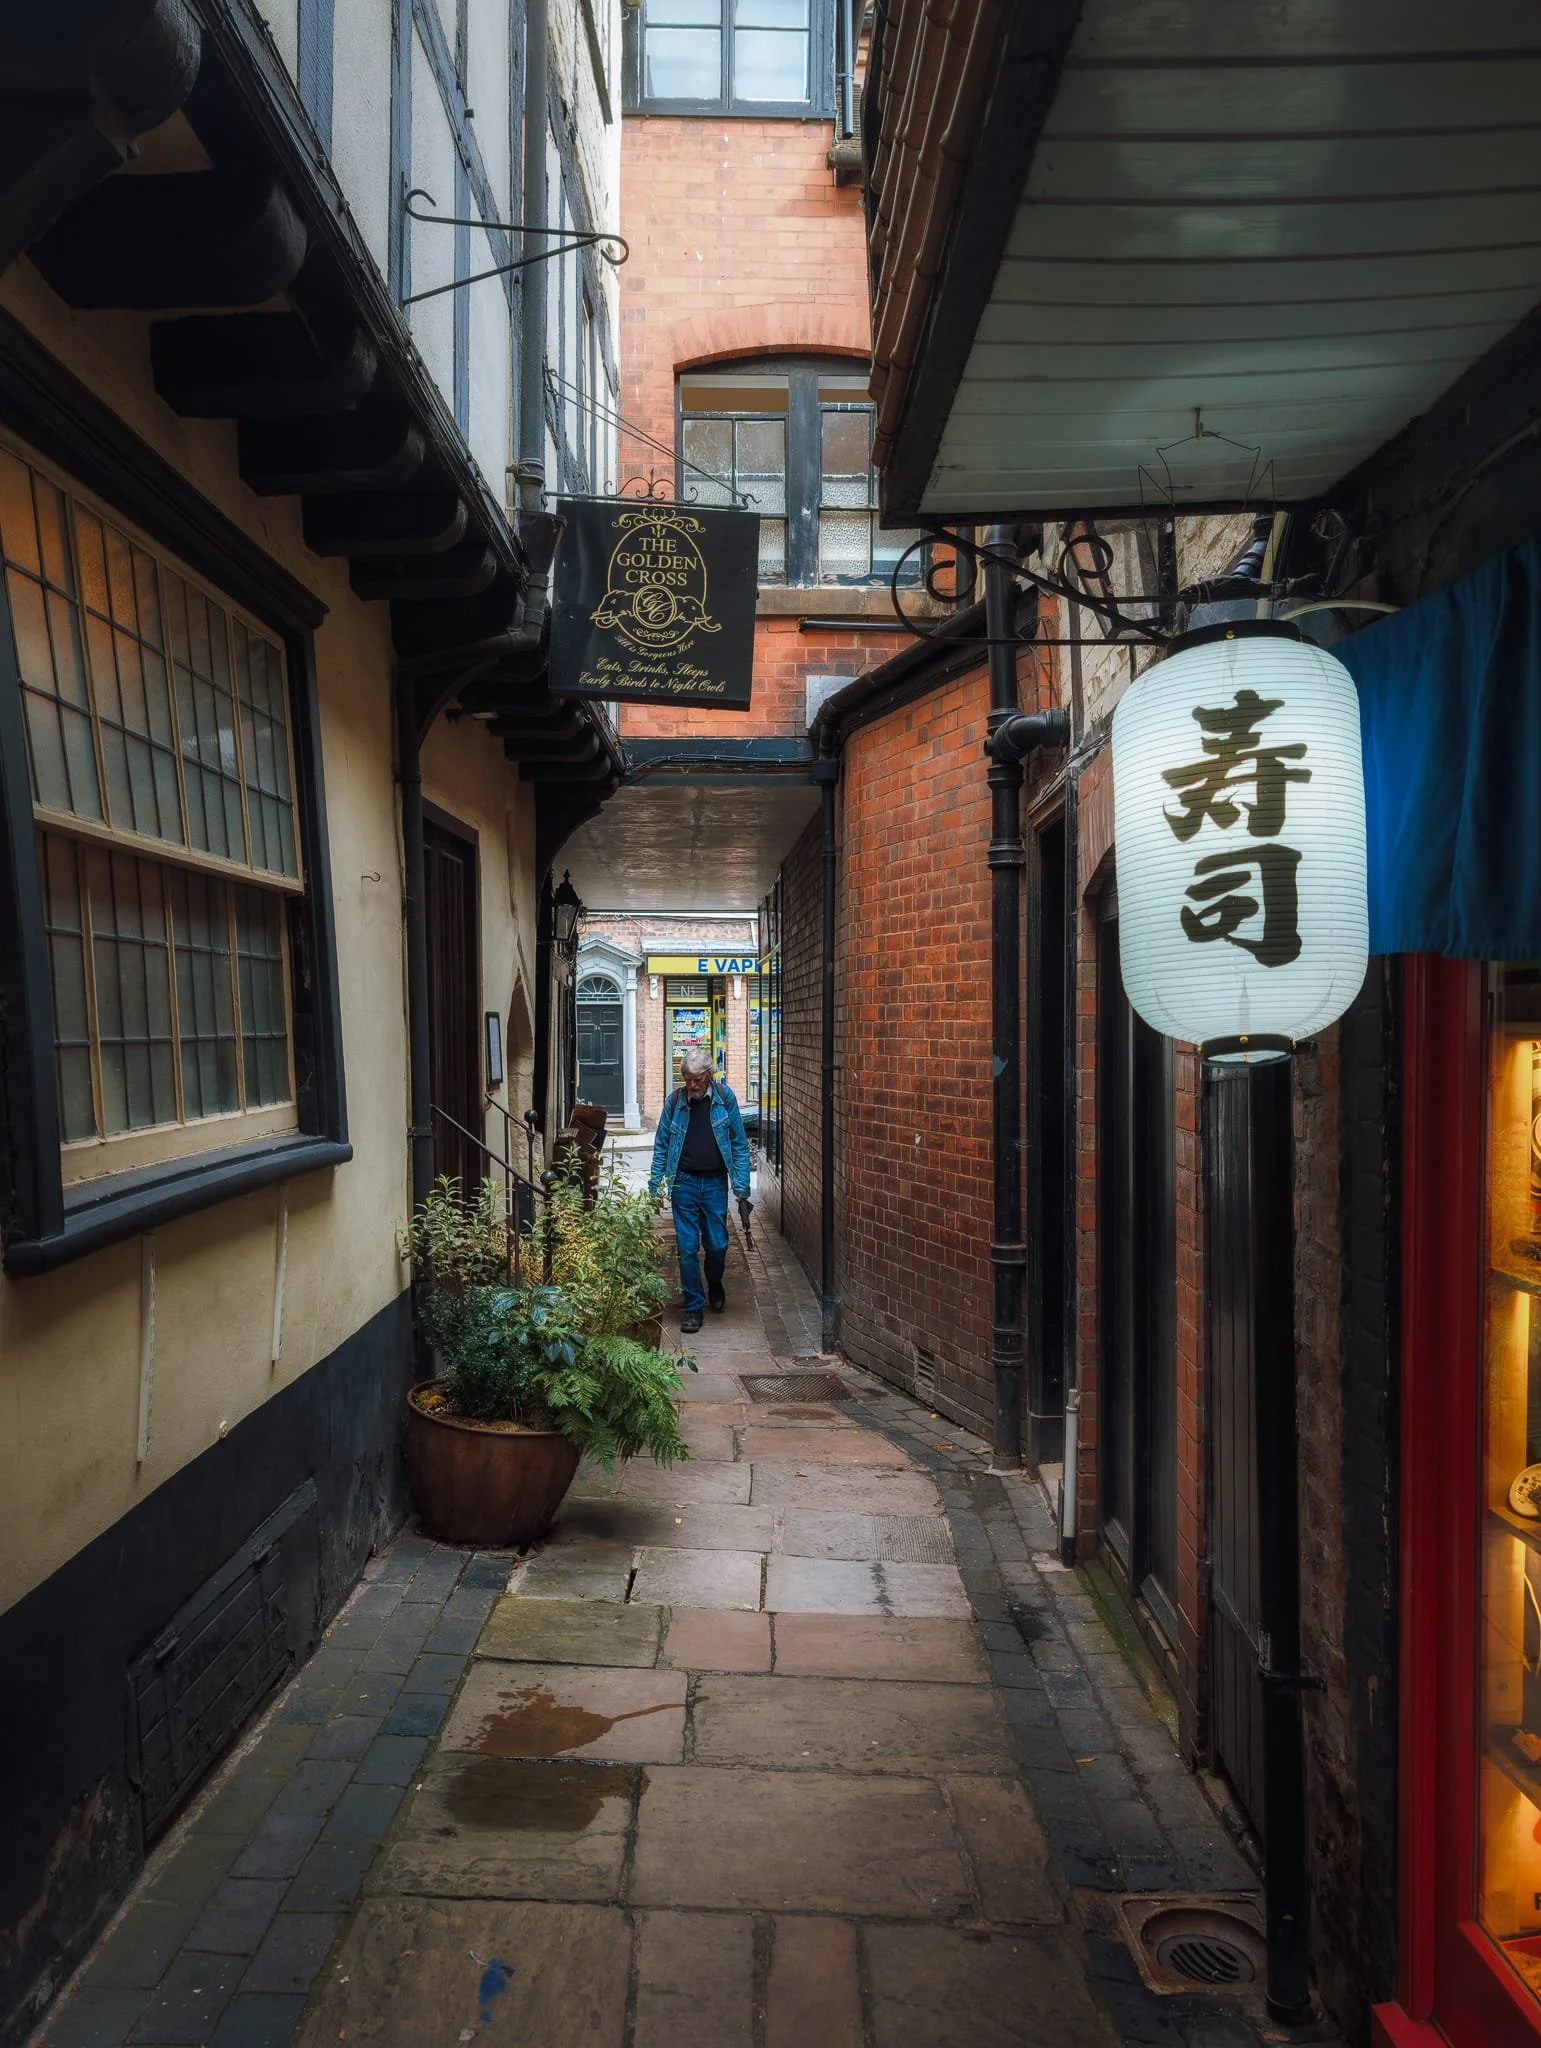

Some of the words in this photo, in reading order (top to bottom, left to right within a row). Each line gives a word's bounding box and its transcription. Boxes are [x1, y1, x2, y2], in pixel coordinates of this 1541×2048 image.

[639, 537, 677, 553] THE
[617, 552, 699, 570] GOLDEN
[625, 569, 687, 586] CROSS
[596, 657, 622, 673] Eats,
[627, 660, 669, 676] Drinks,
[673, 662, 709, 680] Sleeps
[578, 671, 611, 687] Early
[613, 674, 648, 688] Birds
[650, 679, 659, 689] to
[660, 678, 698, 694] Night
[697, 680, 726, 693] Owls
[1161, 690, 1312, 968] 寿司
[698, 959, 708, 972] E
